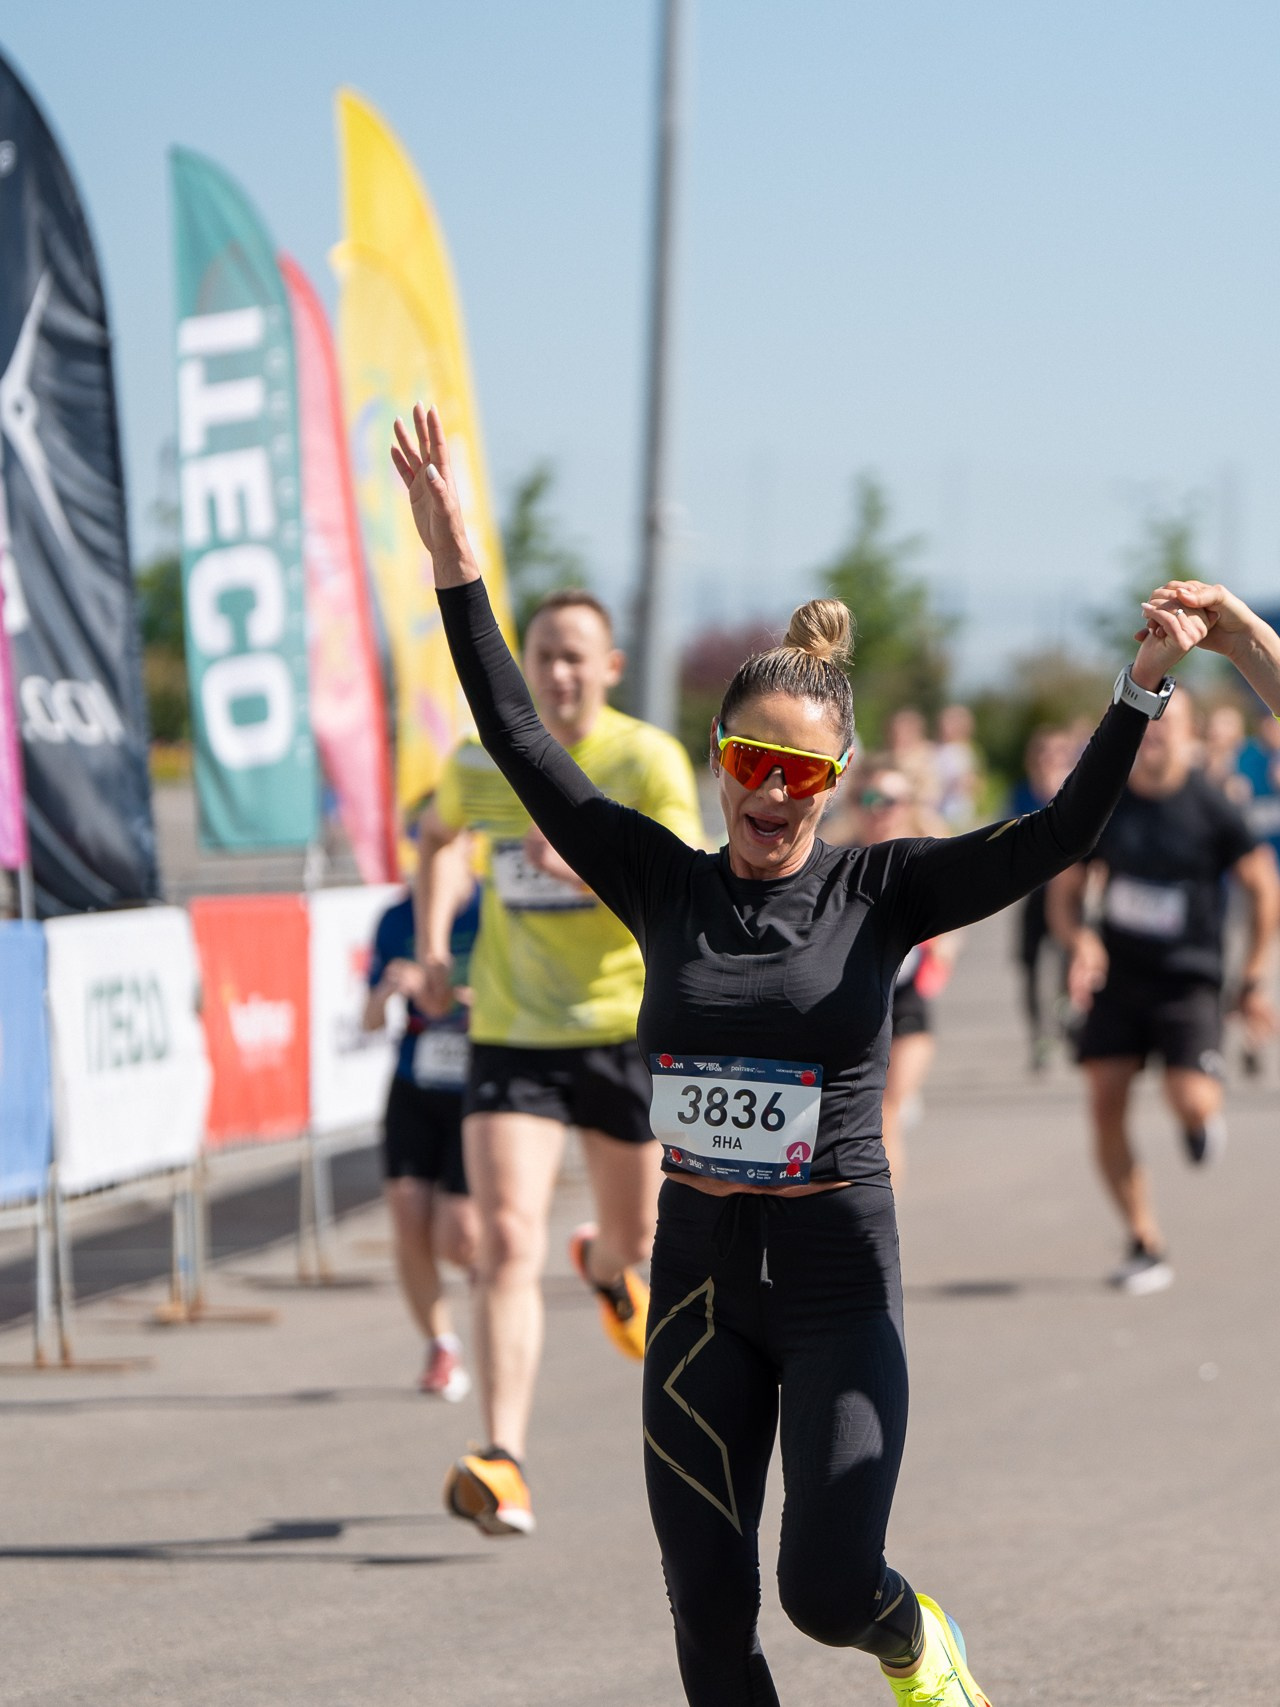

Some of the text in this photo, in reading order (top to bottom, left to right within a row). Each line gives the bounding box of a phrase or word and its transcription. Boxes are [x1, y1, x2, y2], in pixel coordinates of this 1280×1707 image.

[178, 305, 297, 771] ITECO
[677, 1084, 786, 1132] 3836
[712, 1135, 743, 1150] ЯНА
